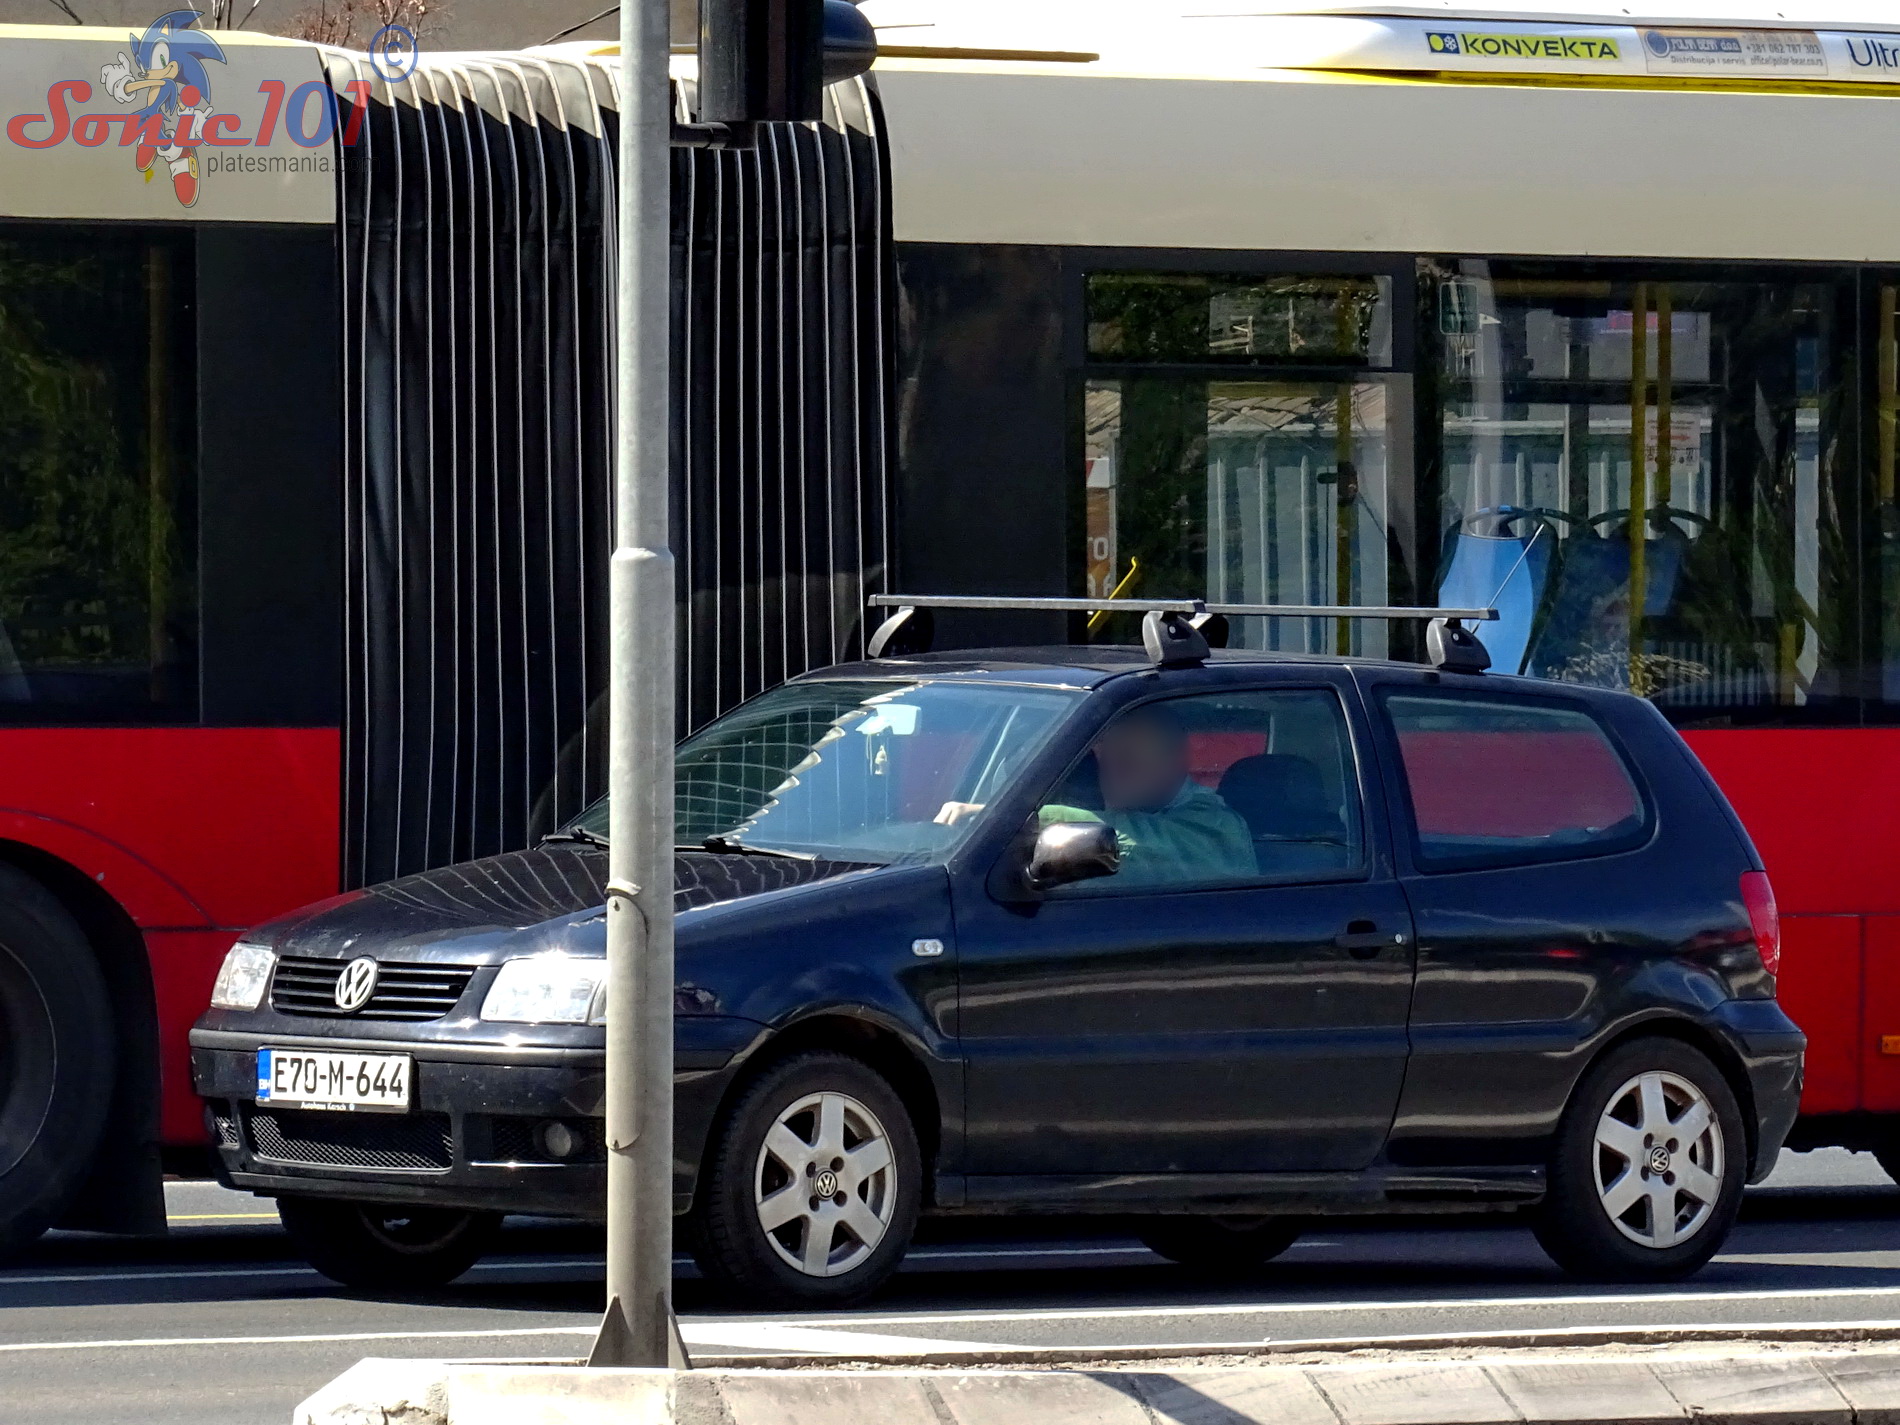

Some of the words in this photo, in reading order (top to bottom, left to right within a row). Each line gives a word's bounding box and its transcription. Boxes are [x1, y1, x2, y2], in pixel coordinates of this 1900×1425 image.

[1461, 33, 1618, 59] KONVEKTA
[1846, 38, 1899, 68] Ultr
[274, 1056, 403, 1098] E70-M-644
